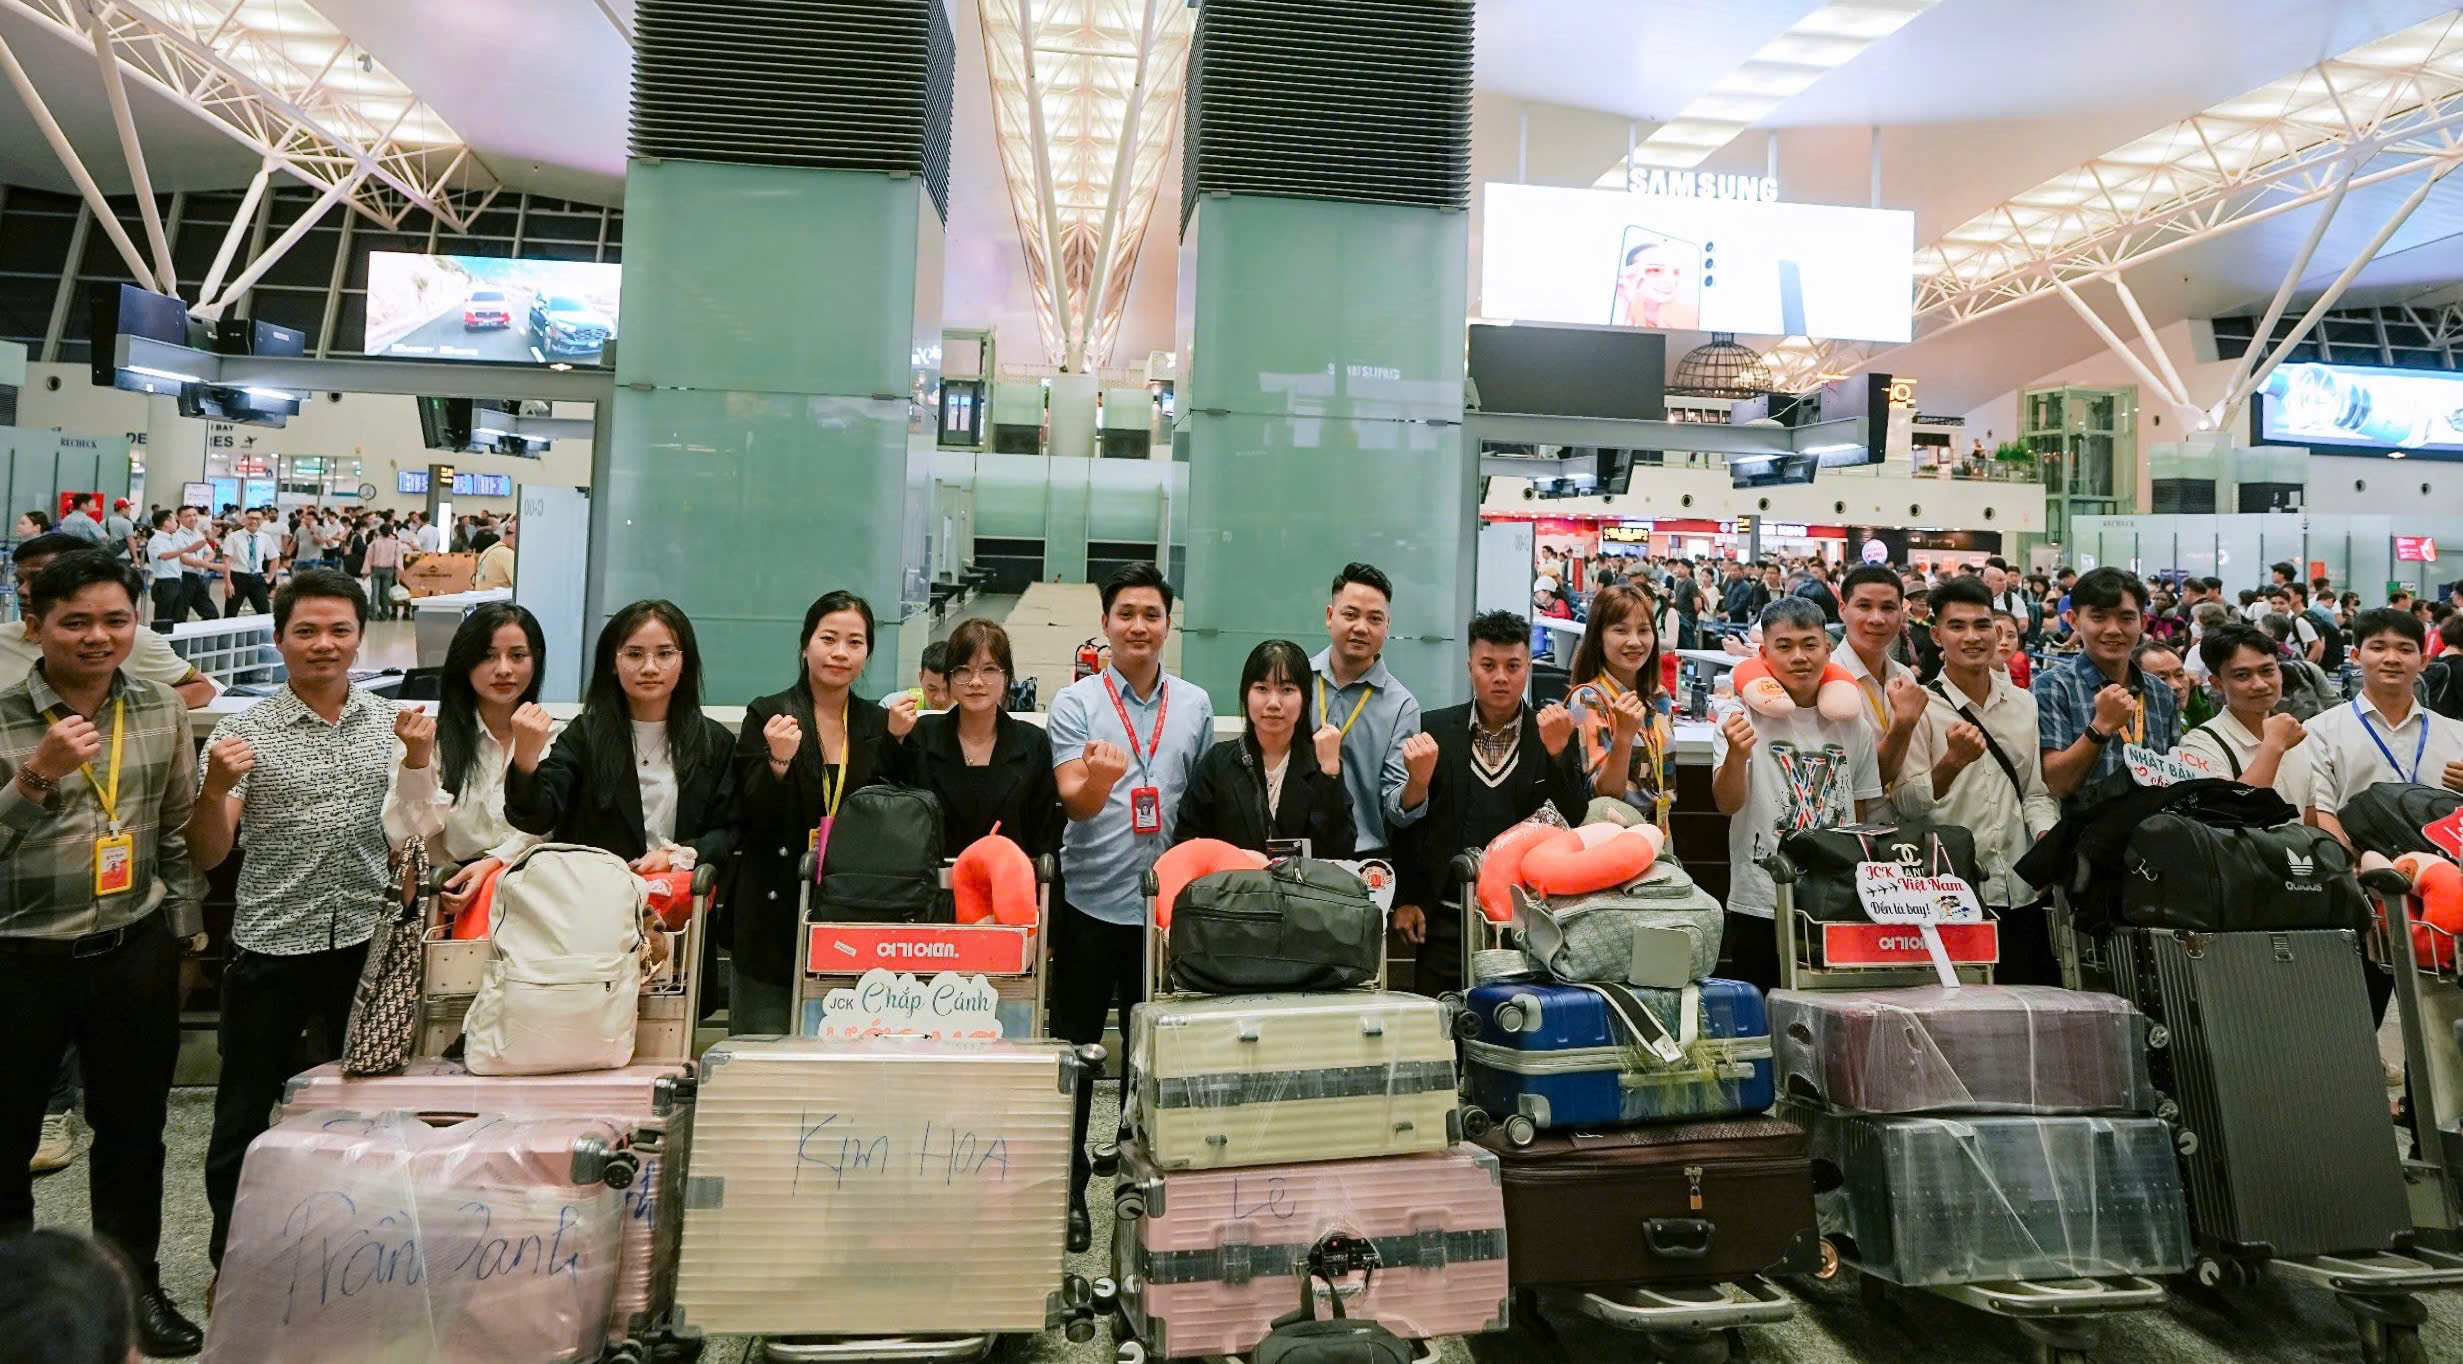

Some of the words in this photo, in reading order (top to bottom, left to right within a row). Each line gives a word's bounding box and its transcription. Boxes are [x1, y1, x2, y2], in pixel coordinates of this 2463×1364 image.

[1629, 166, 1779, 203] SAMSUNG
[60, 437, 97, 449] RECHECK
[1866, 865, 1896, 881] JCK
[1898, 877, 1927, 893] Việt
[1928, 878, 1964, 892] Nam
[1906, 903, 1932, 919] bay!
[830, 998, 854, 1010] JCK
[933, 984, 993, 1016] Cánh
